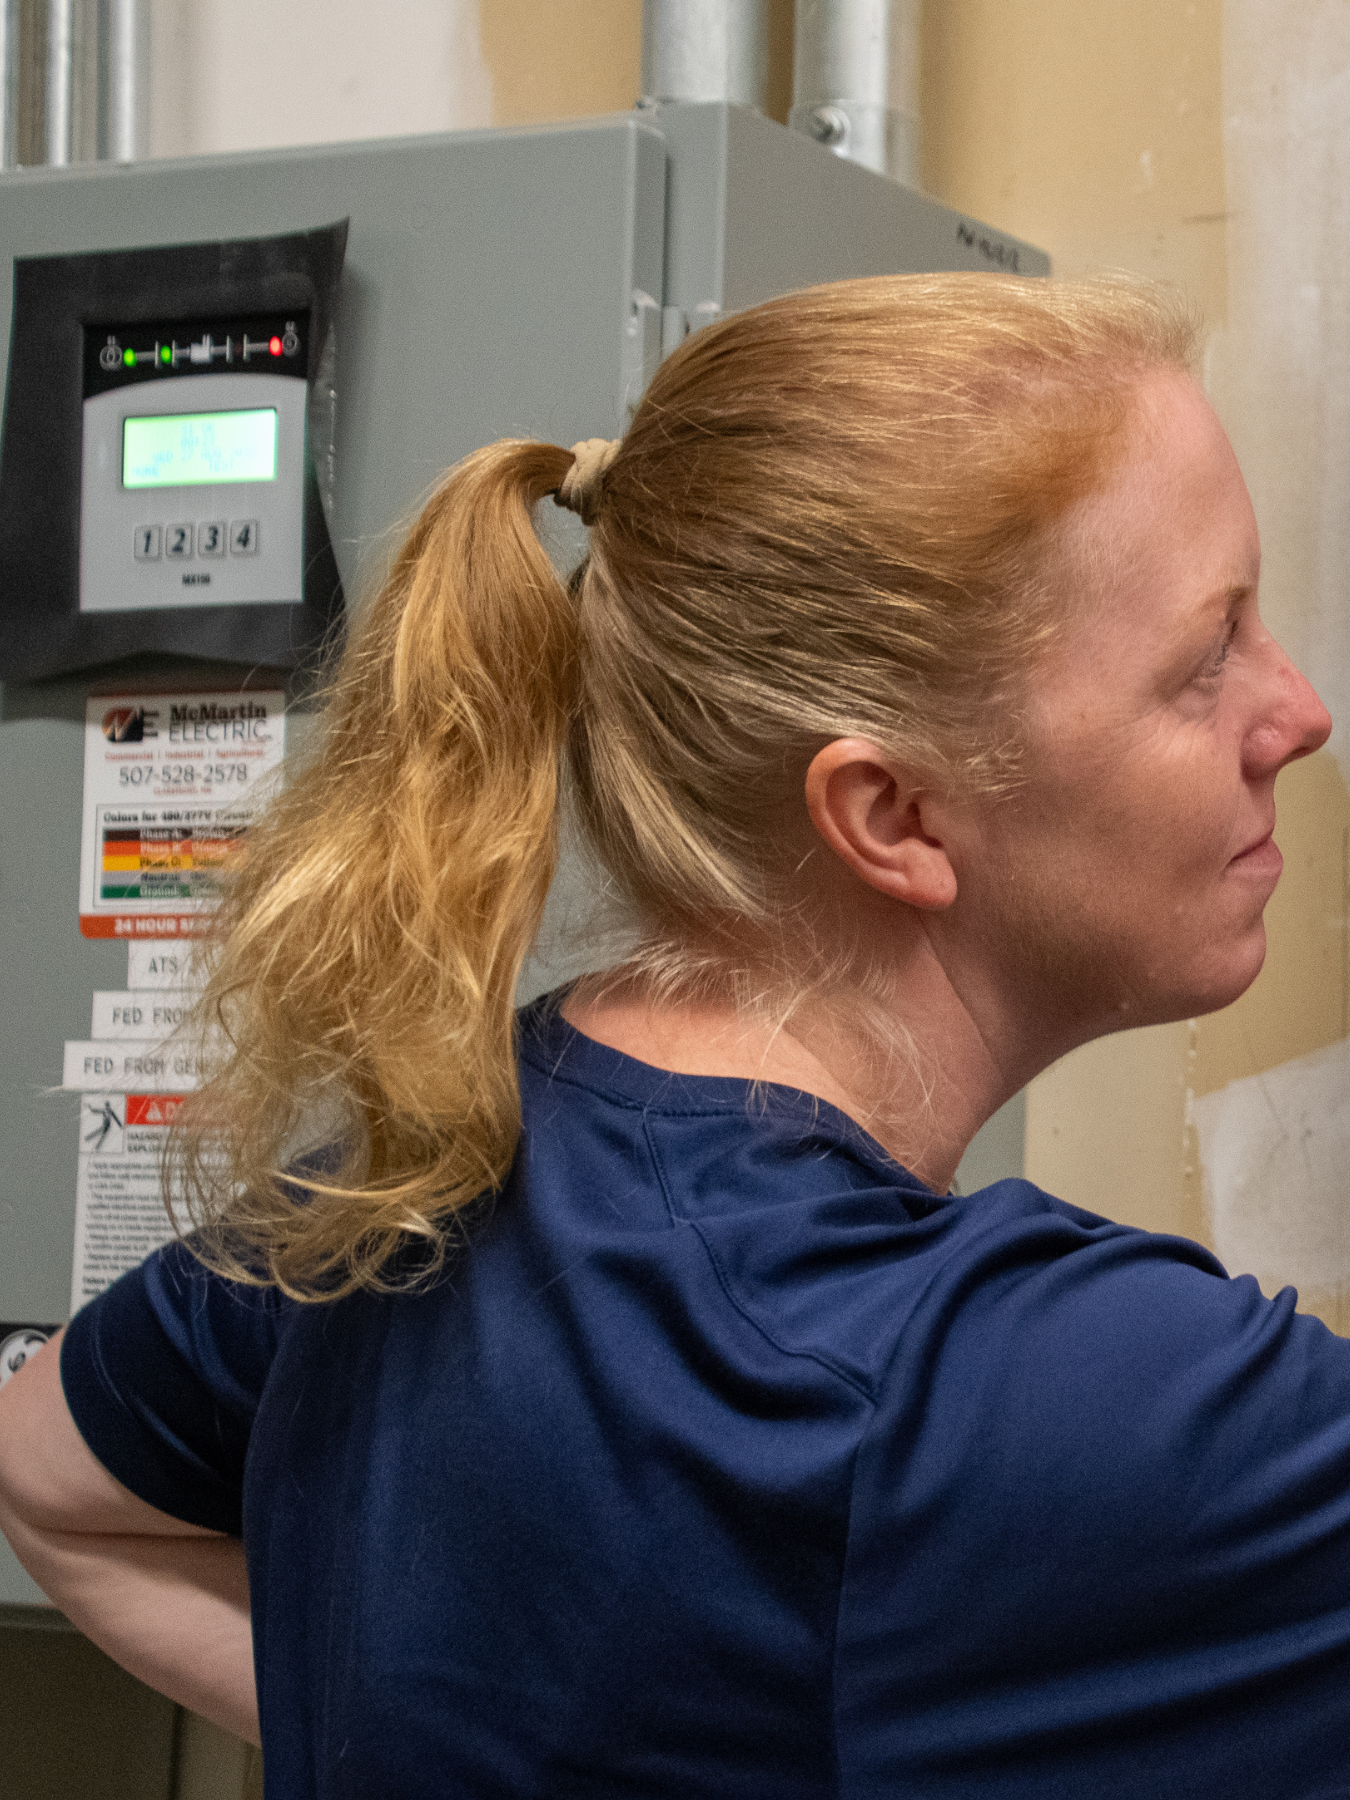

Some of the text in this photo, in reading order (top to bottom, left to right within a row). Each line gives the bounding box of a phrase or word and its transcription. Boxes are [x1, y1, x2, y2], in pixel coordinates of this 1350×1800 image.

[142, 525, 251, 554] 1 2 3 4
[169, 702, 267, 722] McMartin
[169, 718, 267, 741] ELECTRIC
[119, 763, 248, 788] 507-528-2578
[115, 918, 132, 934] 24
[135, 917, 178, 933] HOUR
[149, 956, 179, 974] ATS
[113, 1006, 143, 1025] FED
[83, 1056, 114, 1076] FED
[124, 1056, 165, 1075] FROM
